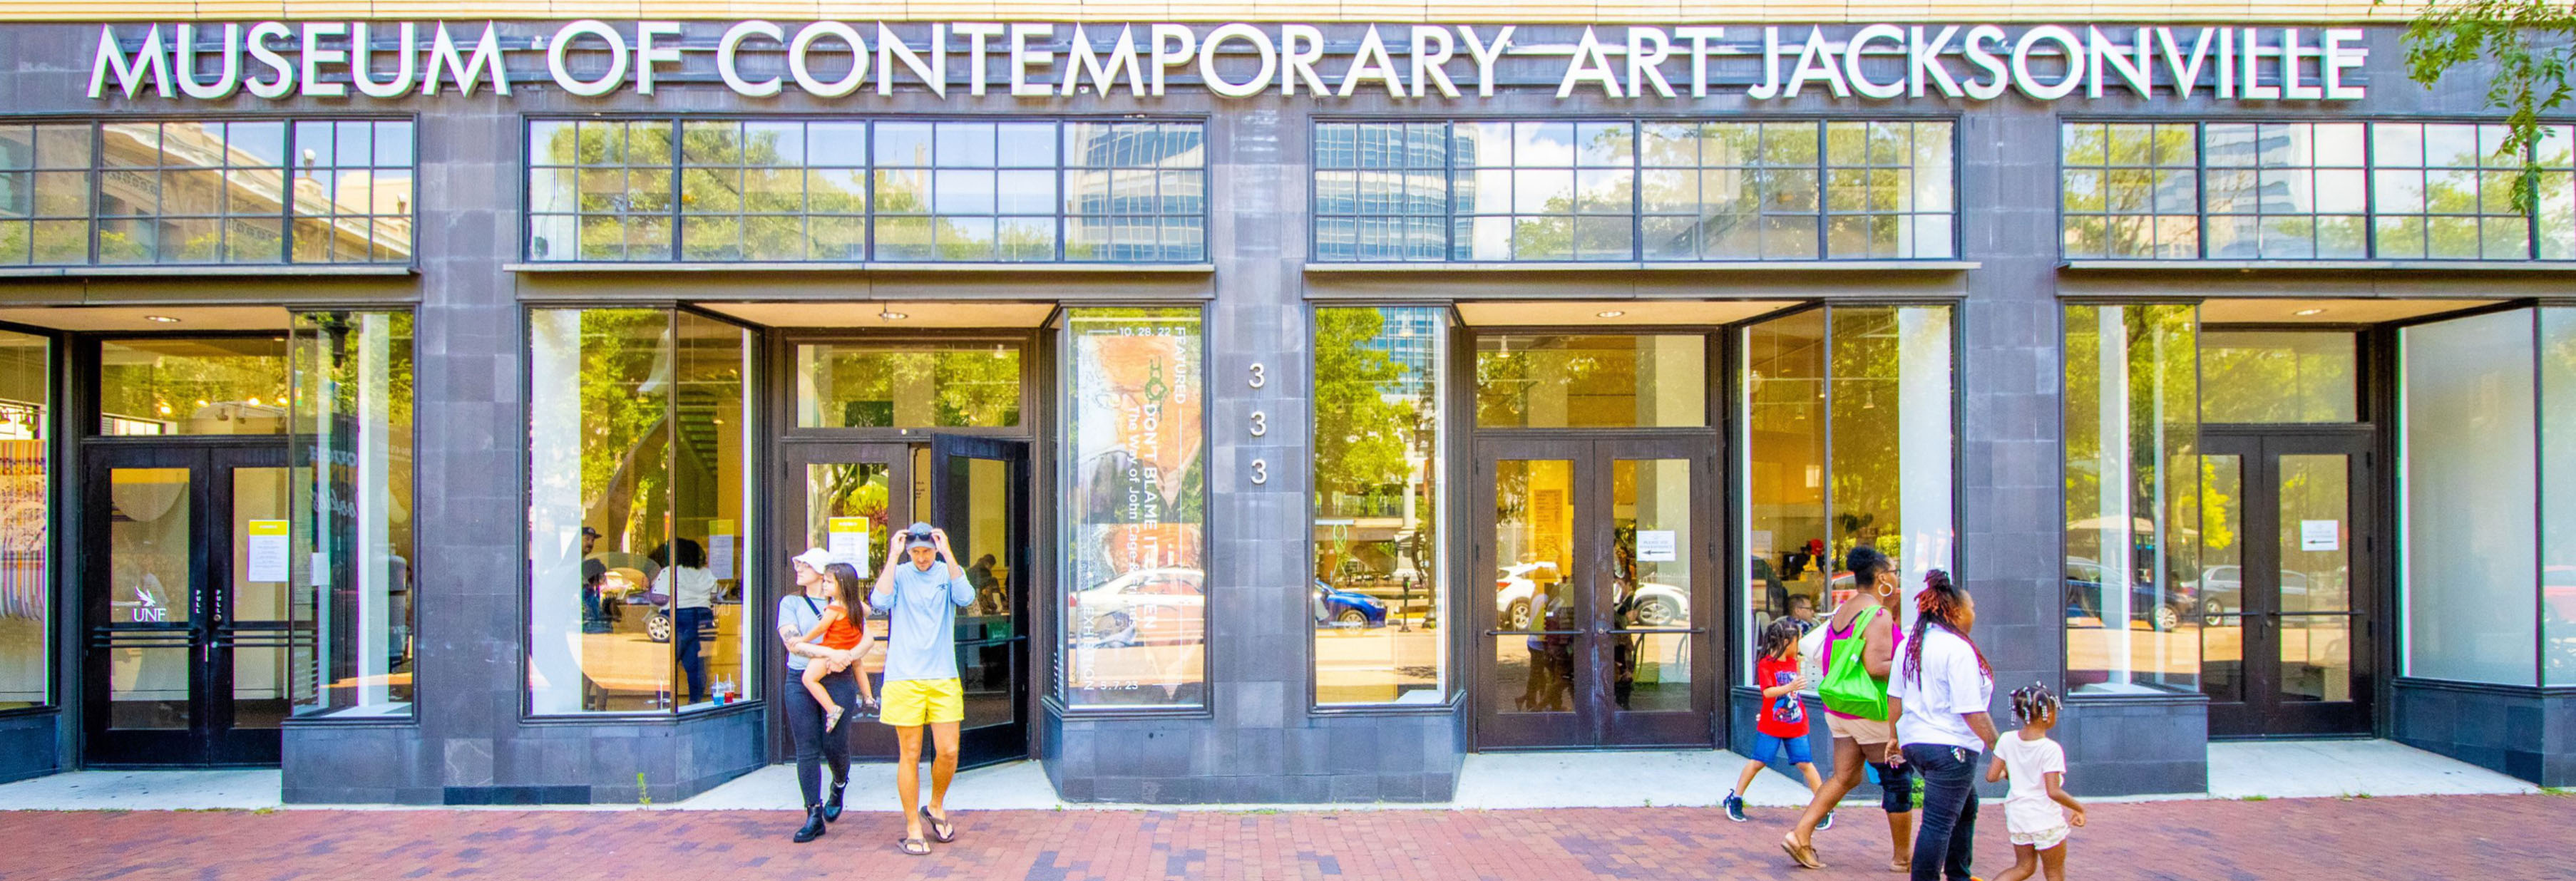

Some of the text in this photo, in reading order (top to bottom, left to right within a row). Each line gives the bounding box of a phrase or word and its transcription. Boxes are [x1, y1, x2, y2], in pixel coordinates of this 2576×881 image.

[87, 17, 2365, 101] MUSEUM OF CONTEMPORARY ART JACKSONVILLE
[1174, 326, 1186, 404] FEATURED
[1129, 405, 1140, 430] The
[1144, 403, 1158, 462] DON'T
[1127, 434, 1140, 464] Way
[1129, 468, 1140, 483] of
[1129, 486, 1140, 520] John
[1144, 467, 1158, 531] BLAME
[1127, 523, 1140, 557] Cage
[1144, 536, 1158, 554] IT
[132, 607, 168, 622] UNF
